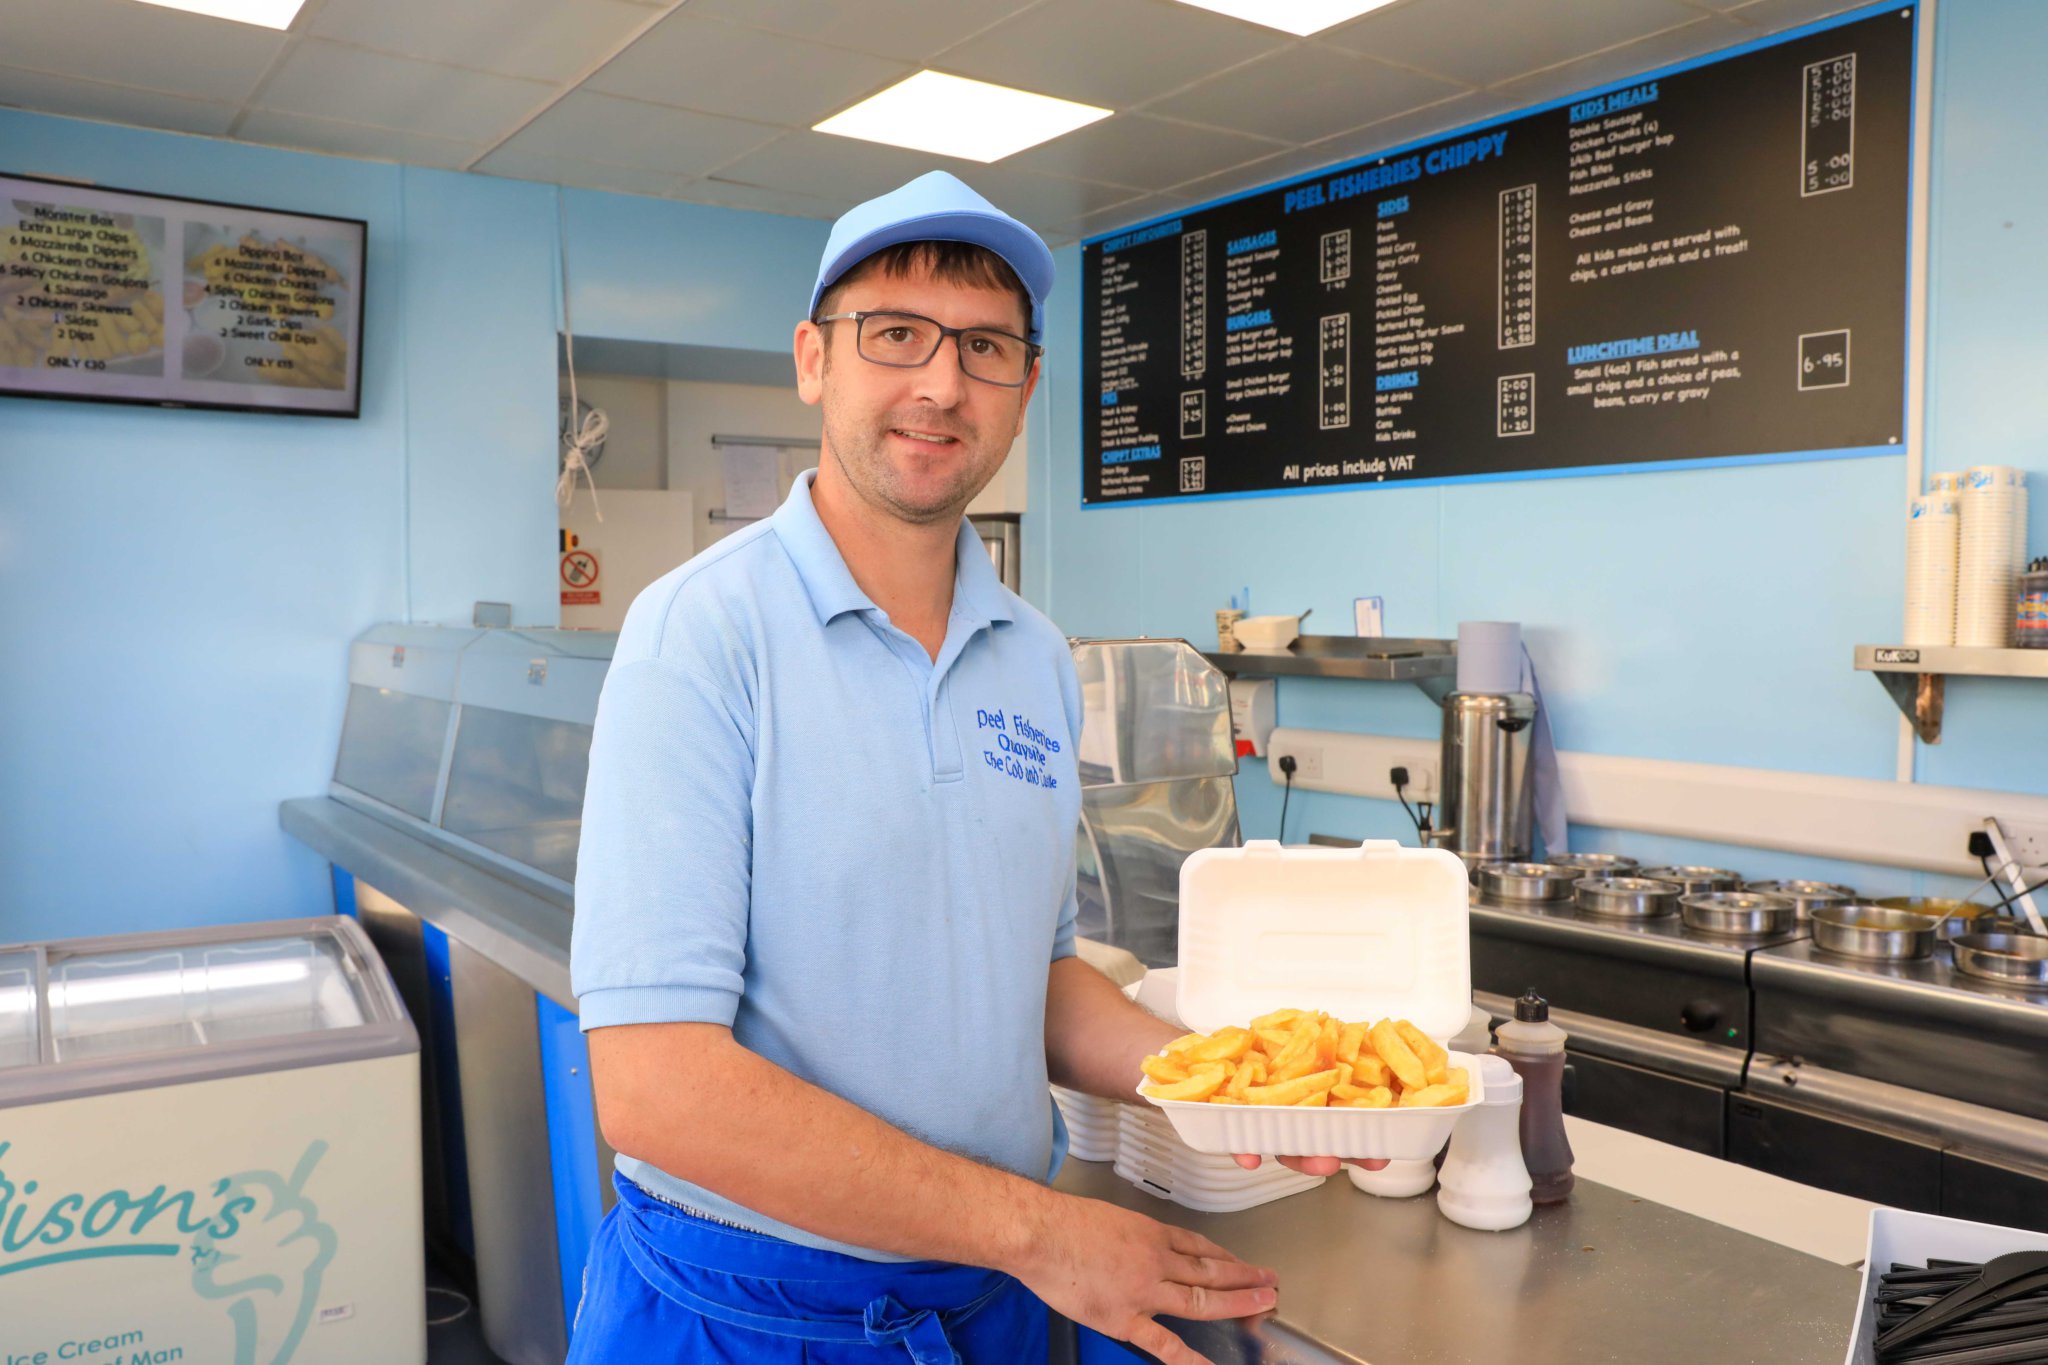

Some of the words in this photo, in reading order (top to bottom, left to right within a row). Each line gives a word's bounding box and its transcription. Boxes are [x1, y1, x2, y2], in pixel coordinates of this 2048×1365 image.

[1570, 99, 1605, 124] KIDS
[1608, 83, 1658, 112] MEALS
[1570, 123, 1601, 139] Double
[1603, 112, 1643, 129] Sausage
[1570, 137, 1605, 152] Chicken
[1607, 127, 1641, 143] Chunks
[1595, 147, 1616, 161] Beef
[1619, 138, 1653, 155] burger
[1655, 134, 1675, 147] bap
[1284, 184, 1325, 214] PEEL
[1329, 157, 1422, 201] FISHERIES
[1425, 131, 1508, 174] CHIPPY
[1570, 168, 1588, 181] Fish
[1591, 164, 1613, 176] Bites
[1570, 177, 1621, 195] Mozzarella
[1624, 169, 1653, 183] Sticks
[34, 208, 86, 222] Monster
[91, 214, 114, 226] Box
[1377, 196, 1409, 219] SIDES
[1570, 211, 1602, 224] Cheese
[1604, 204, 1622, 217] and
[1625, 199, 1654, 215] Gravy
[20, 220, 52, 233] Extra
[57, 226, 92, 240] Large
[96, 230, 129, 243] Chips
[1377, 221, 1394, 232] Peas
[1570, 225, 1602, 239] Cheese
[1604, 219, 1622, 231] and
[1625, 213, 1653, 227] Beans
[10, 236, 17, 245] 6
[21, 236, 88, 252] Mozzarella
[93, 245, 138, 260] Dippers
[1377, 233, 1398, 244] Beans
[1394, 242, 1416, 253] Curry
[1576, 254, 1591, 266] All
[1594, 249, 1615, 262] kids
[1618, 243, 1648, 258] meals
[1651, 240, 1670, 251] are
[1673, 229, 1711, 248] served
[1714, 225, 1741, 239] with
[21, 252, 28, 261] 6
[32, 252, 81, 265] Chicken
[85, 258, 128, 272] Chunks
[1377, 258, 1396, 270] Spicy
[1398, 254, 1420, 265] Curry
[1570, 268, 1598, 283] chips,
[1601, 266, 1608, 277] a
[1611, 258, 1644, 275] carton
[1648, 254, 1675, 268] drink
[1679, 248, 1699, 263] and
[1703, 249, 1711, 258] a
[11, 265, 45, 279] Spicy
[50, 269, 98, 283] Chicken
[102, 275, 149, 289] Goujons
[234, 273, 276, 286] Chicken
[1376, 272, 1398, 282] Gravy
[44, 285, 50, 293] 4
[56, 285, 107, 300] Sausage
[1376, 284, 1402, 295] Cheese
[18, 296, 24, 306] 2
[28, 297, 77, 310] Chicken
[82, 302, 132, 315] Skewers
[229, 300, 272, 313] Chicken
[1376, 295, 1402, 307] Pickled
[1403, 293, 1418, 303] Egg
[65, 314, 98, 327] Sides
[1226, 309, 1272, 332] BURGERS
[1376, 307, 1402, 320] Pickled
[1403, 305, 1425, 315] Onion
[58, 329, 64, 338] 2
[69, 329, 95, 341] Dips
[1376, 320, 1408, 333] Buttered
[1410, 318, 1424, 327] Bap
[1376, 331, 1414, 345] Homemade
[1441, 324, 1464, 335] Sauce
[232, 329, 265, 340] Sweet
[295, 333, 317, 345] Dips
[1376, 346, 1397, 358] Garlic
[1399, 343, 1419, 354] Mayo
[1421, 341, 1433, 352] Dip
[1568, 336, 1655, 365] LUNCHTIME
[1657, 330, 1700, 350] DEAL
[47, 356, 81, 368] ONLY
[244, 356, 273, 367] ONLY
[1376, 359, 1398, 371] Sweet
[1400, 356, 1418, 367] Chilli
[1421, 355, 1433, 366] Dip
[1574, 366, 1602, 380] Small
[1604, 362, 1631, 377] (4oz)
[1636, 359, 1659, 372] Fish
[1661, 354, 1699, 369] served
[1702, 351, 1727, 363] with
[1731, 351, 1739, 361] a
[1376, 371, 1419, 392] DRINKS
[1567, 383, 1592, 396] small
[1595, 380, 1622, 394] chips
[1624, 376, 1644, 389] and
[1647, 376, 1655, 387] a
[1658, 371, 1692, 386] choice
[1695, 368, 1708, 381] of
[1711, 367, 1741, 382] peas,
[1375, 395, 1388, 404] Hot
[1390, 392, 1413, 402] drinks
[1594, 395, 1626, 408] beans,
[1629, 392, 1659, 405] curry
[1662, 390, 1675, 401] or
[1678, 387, 1710, 403] gravy
[1375, 406, 1401, 417] Bottles
[1375, 421, 1393, 430] Cans
[1375, 432, 1391, 442] Kids
[1393, 430, 1416, 441] Drinks
[1283, 465, 1299, 480] All
[1304, 463, 1339, 482] prices
[1343, 458, 1386, 475] include
[1388, 455, 1415, 471] VAT
[977, 709, 1005, 730] Peel
[1013, 714, 1060, 752] Fisheries
[984, 750, 1003, 771] The
[57, 1329, 144, 1360] Cream
[131, 1346, 183, 1365] Man
